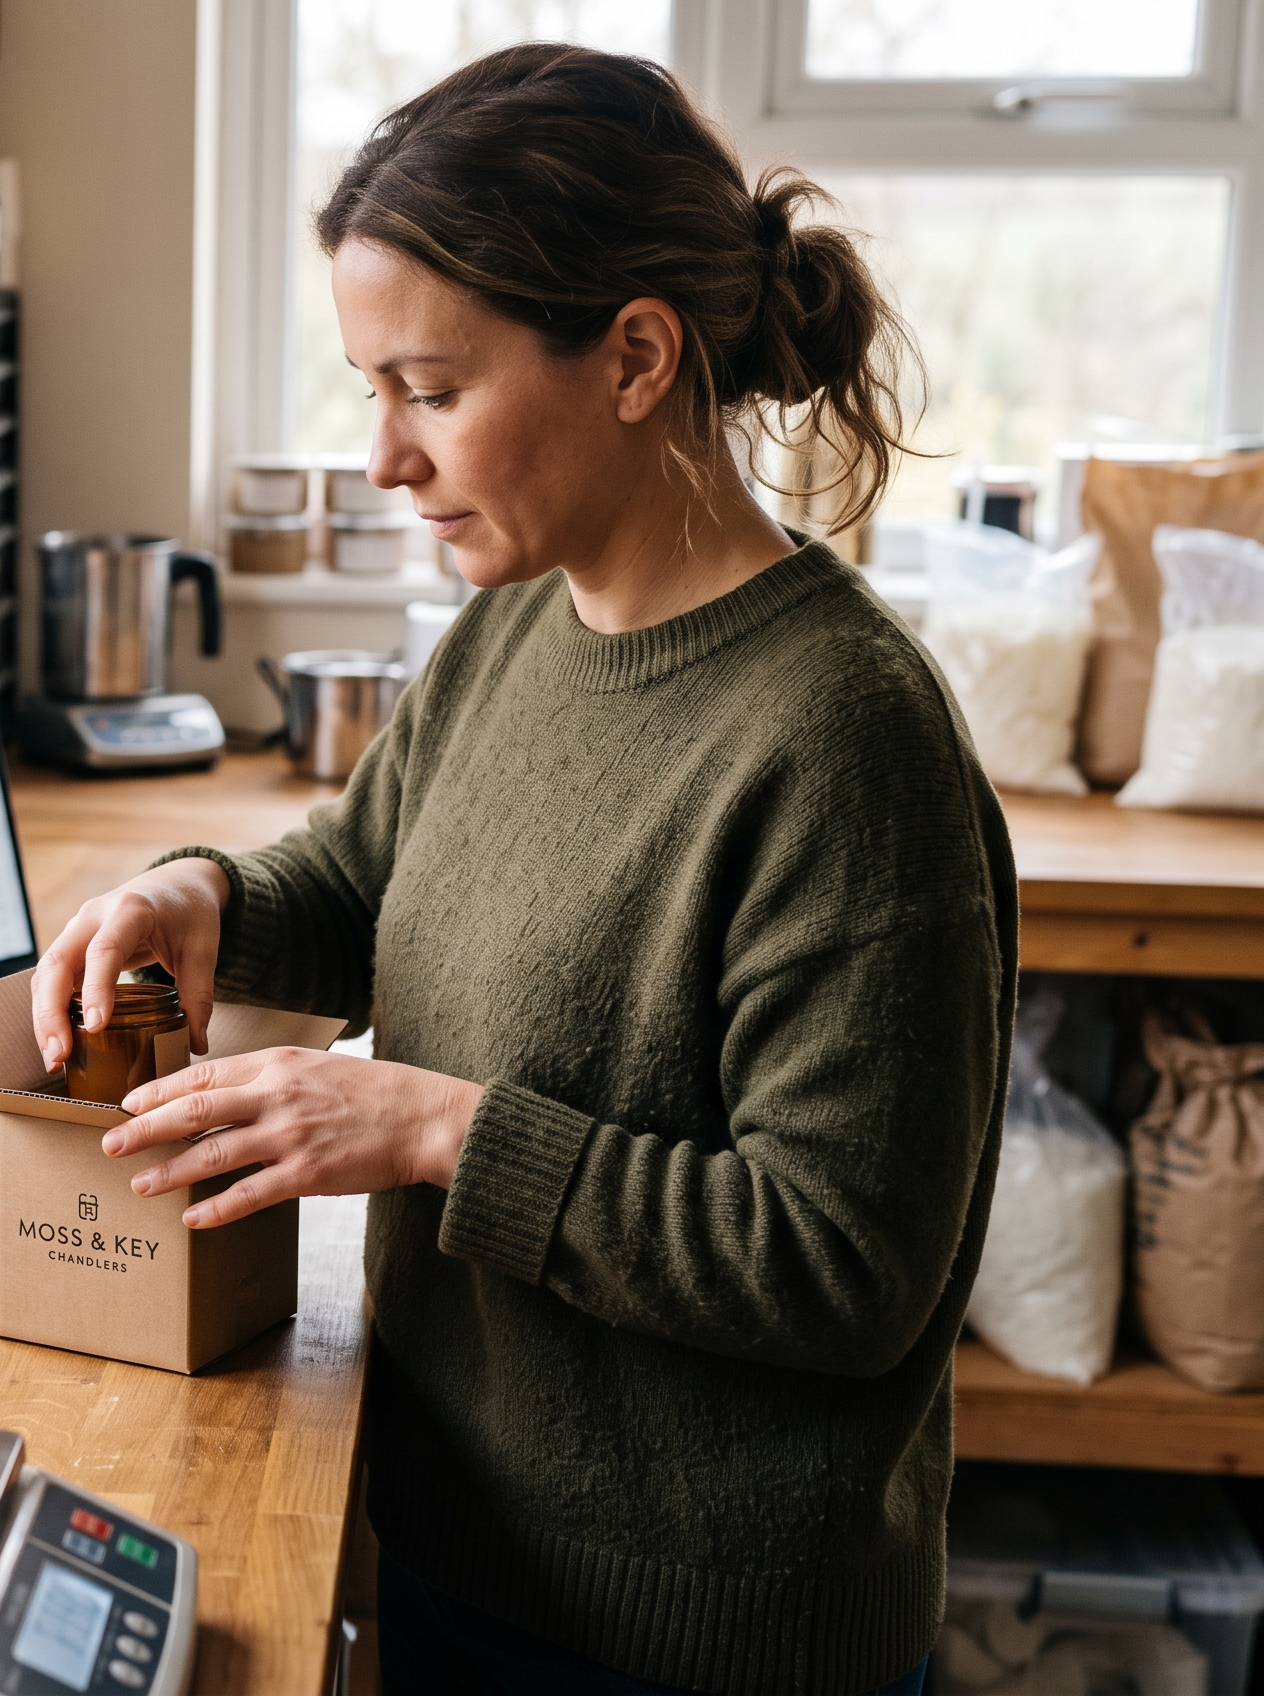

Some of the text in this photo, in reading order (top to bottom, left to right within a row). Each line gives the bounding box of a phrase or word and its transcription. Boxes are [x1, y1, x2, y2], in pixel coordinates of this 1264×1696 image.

[19, 1218, 160, 1260] MOSS & KEY
[48, 1250, 127, 1273] CHANDLERS
